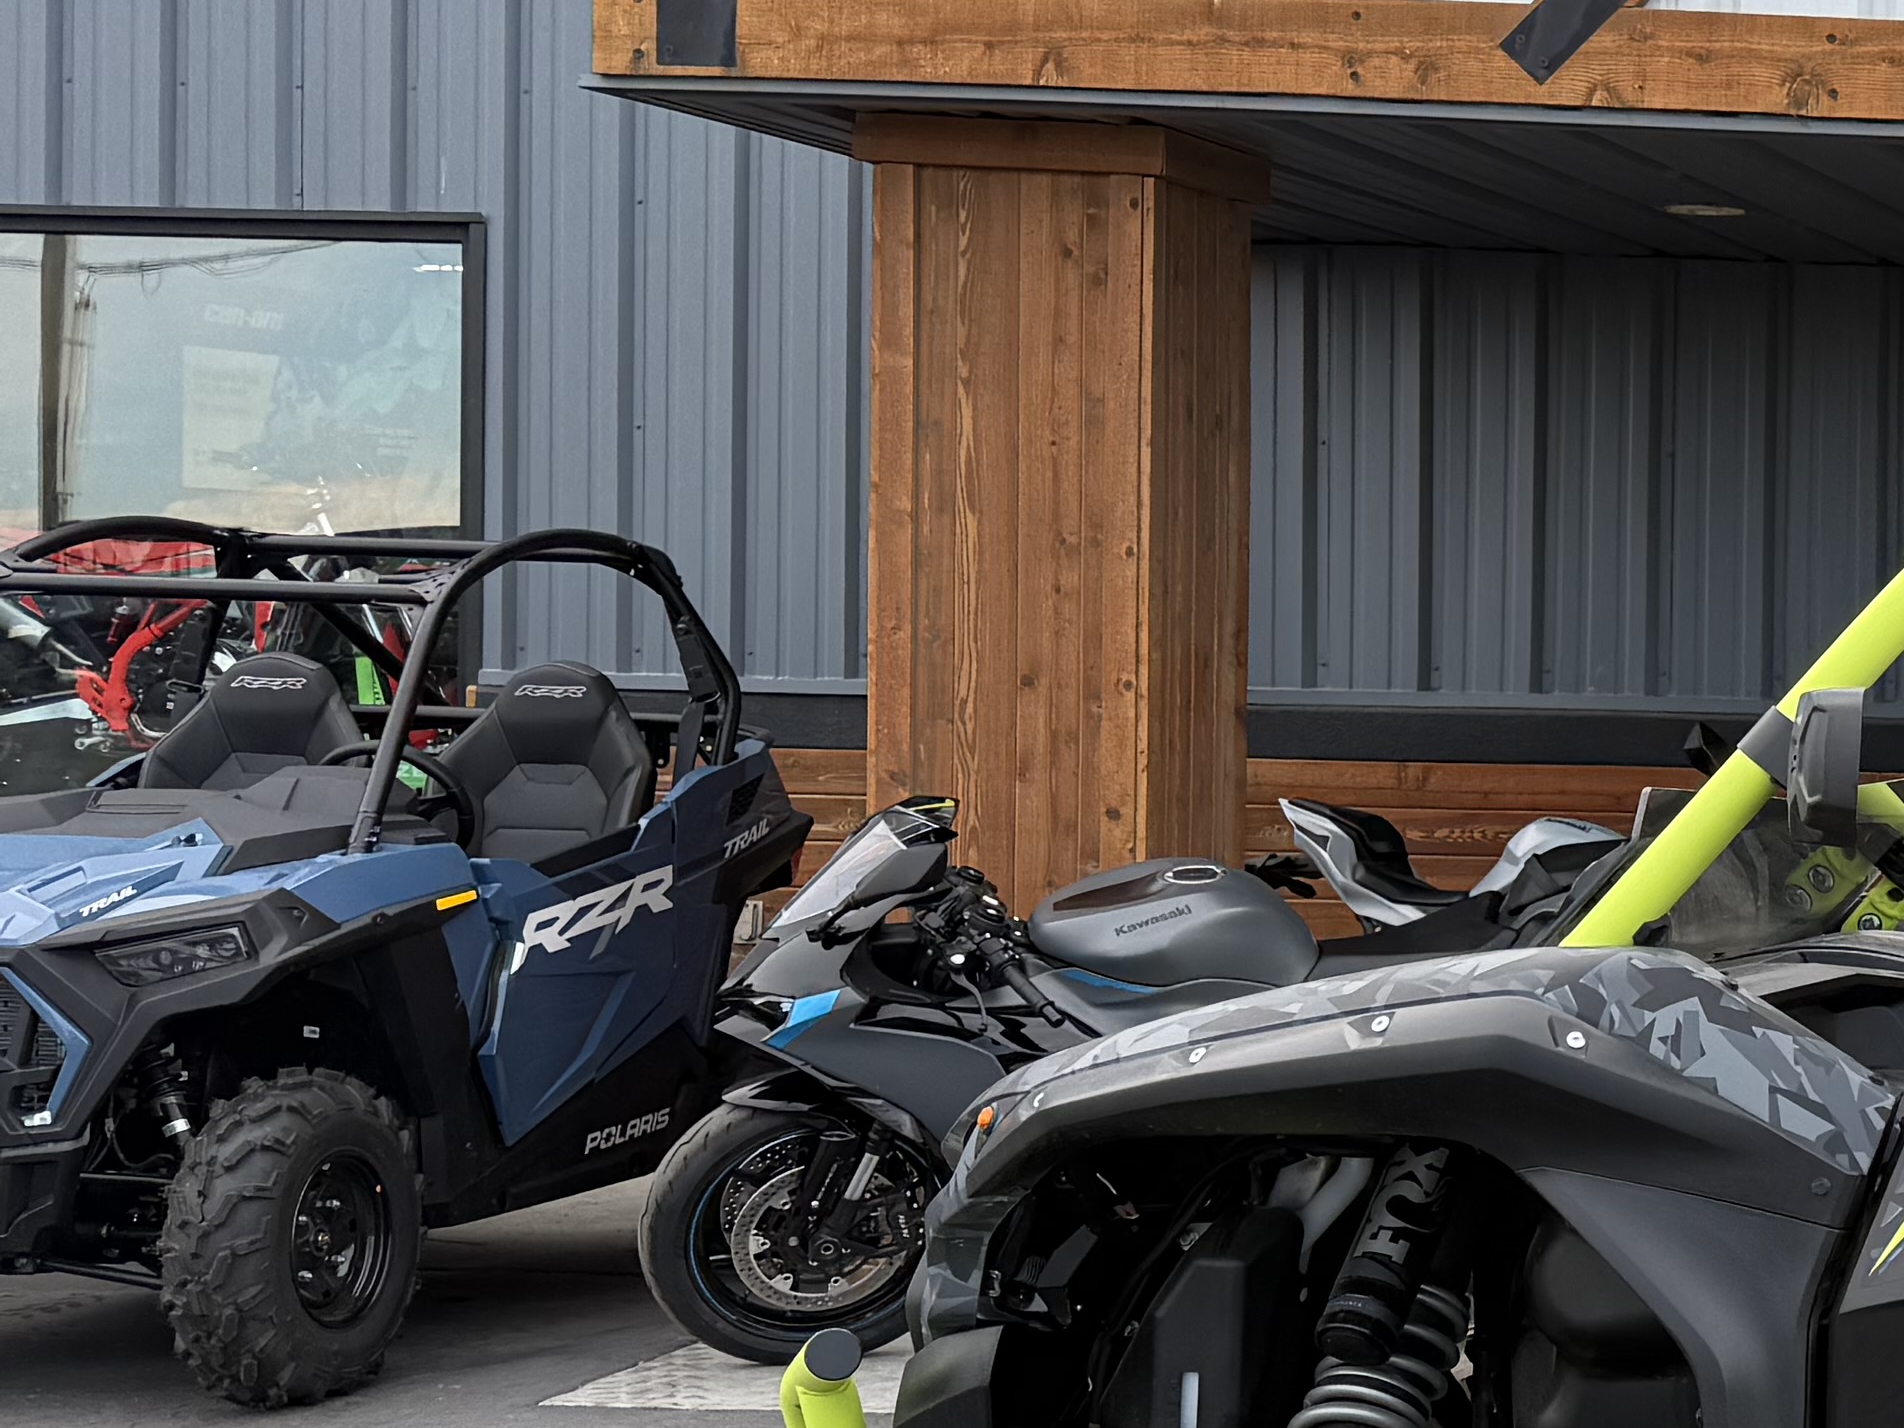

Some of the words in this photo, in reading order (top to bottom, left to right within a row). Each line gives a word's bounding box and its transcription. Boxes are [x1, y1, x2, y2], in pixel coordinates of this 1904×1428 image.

[723, 818, 770, 860] TRAIL
[79, 885, 138, 917] TRAIL
[511, 864, 674, 974] RZR
[1114, 904, 1193, 937] Kawasaki
[584, 1107, 671, 1155] POLARIS
[1351, 1144, 1450, 1264] FOX
